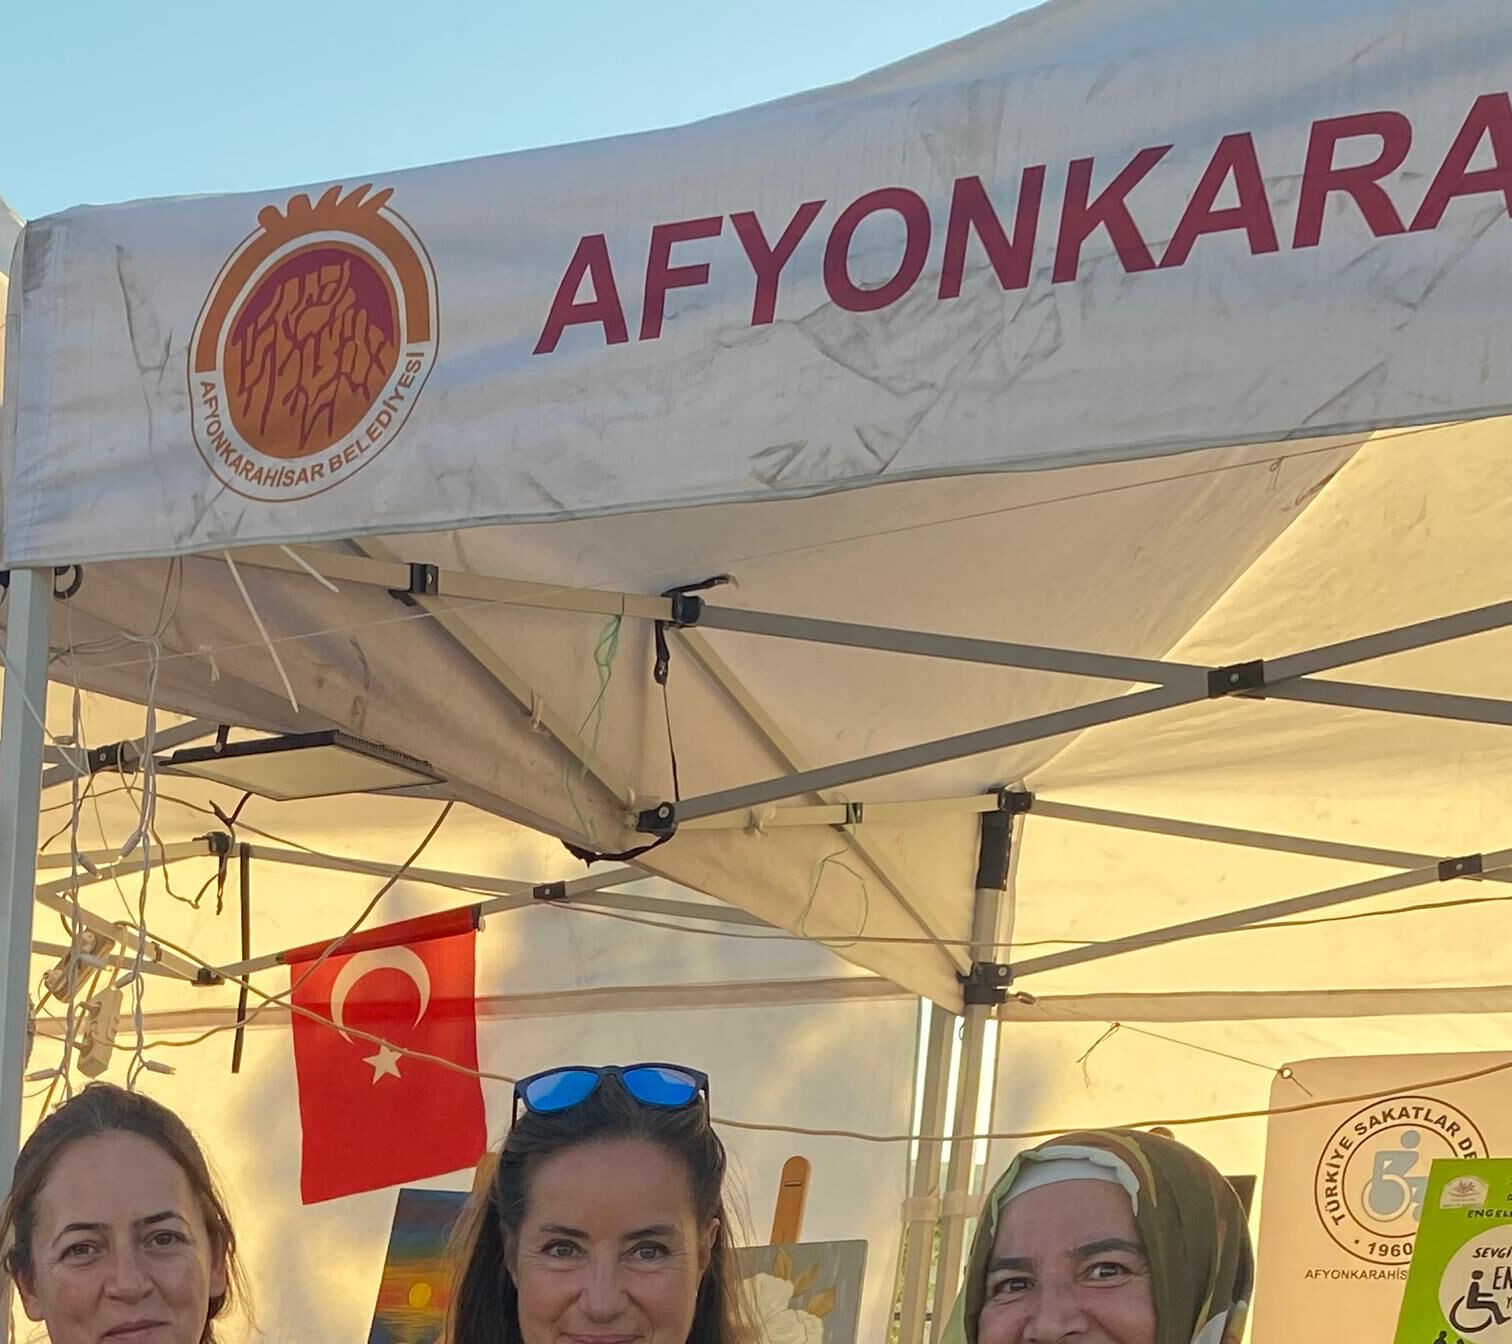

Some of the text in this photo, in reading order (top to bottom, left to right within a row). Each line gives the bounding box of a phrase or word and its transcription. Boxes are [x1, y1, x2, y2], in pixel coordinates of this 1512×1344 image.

[532, 92, 1512, 355] AFYONKARA
[200, 380, 325, 488] AFYONKARAHİSAR
[1325, 1136, 1355, 1226] TÜRKİYE
[1354, 1106, 1461, 1138] SAKATLAR
[1305, 1268, 1408, 1280] AFYONKARAHİS
[1368, 1242, 1412, 1257] 1960
